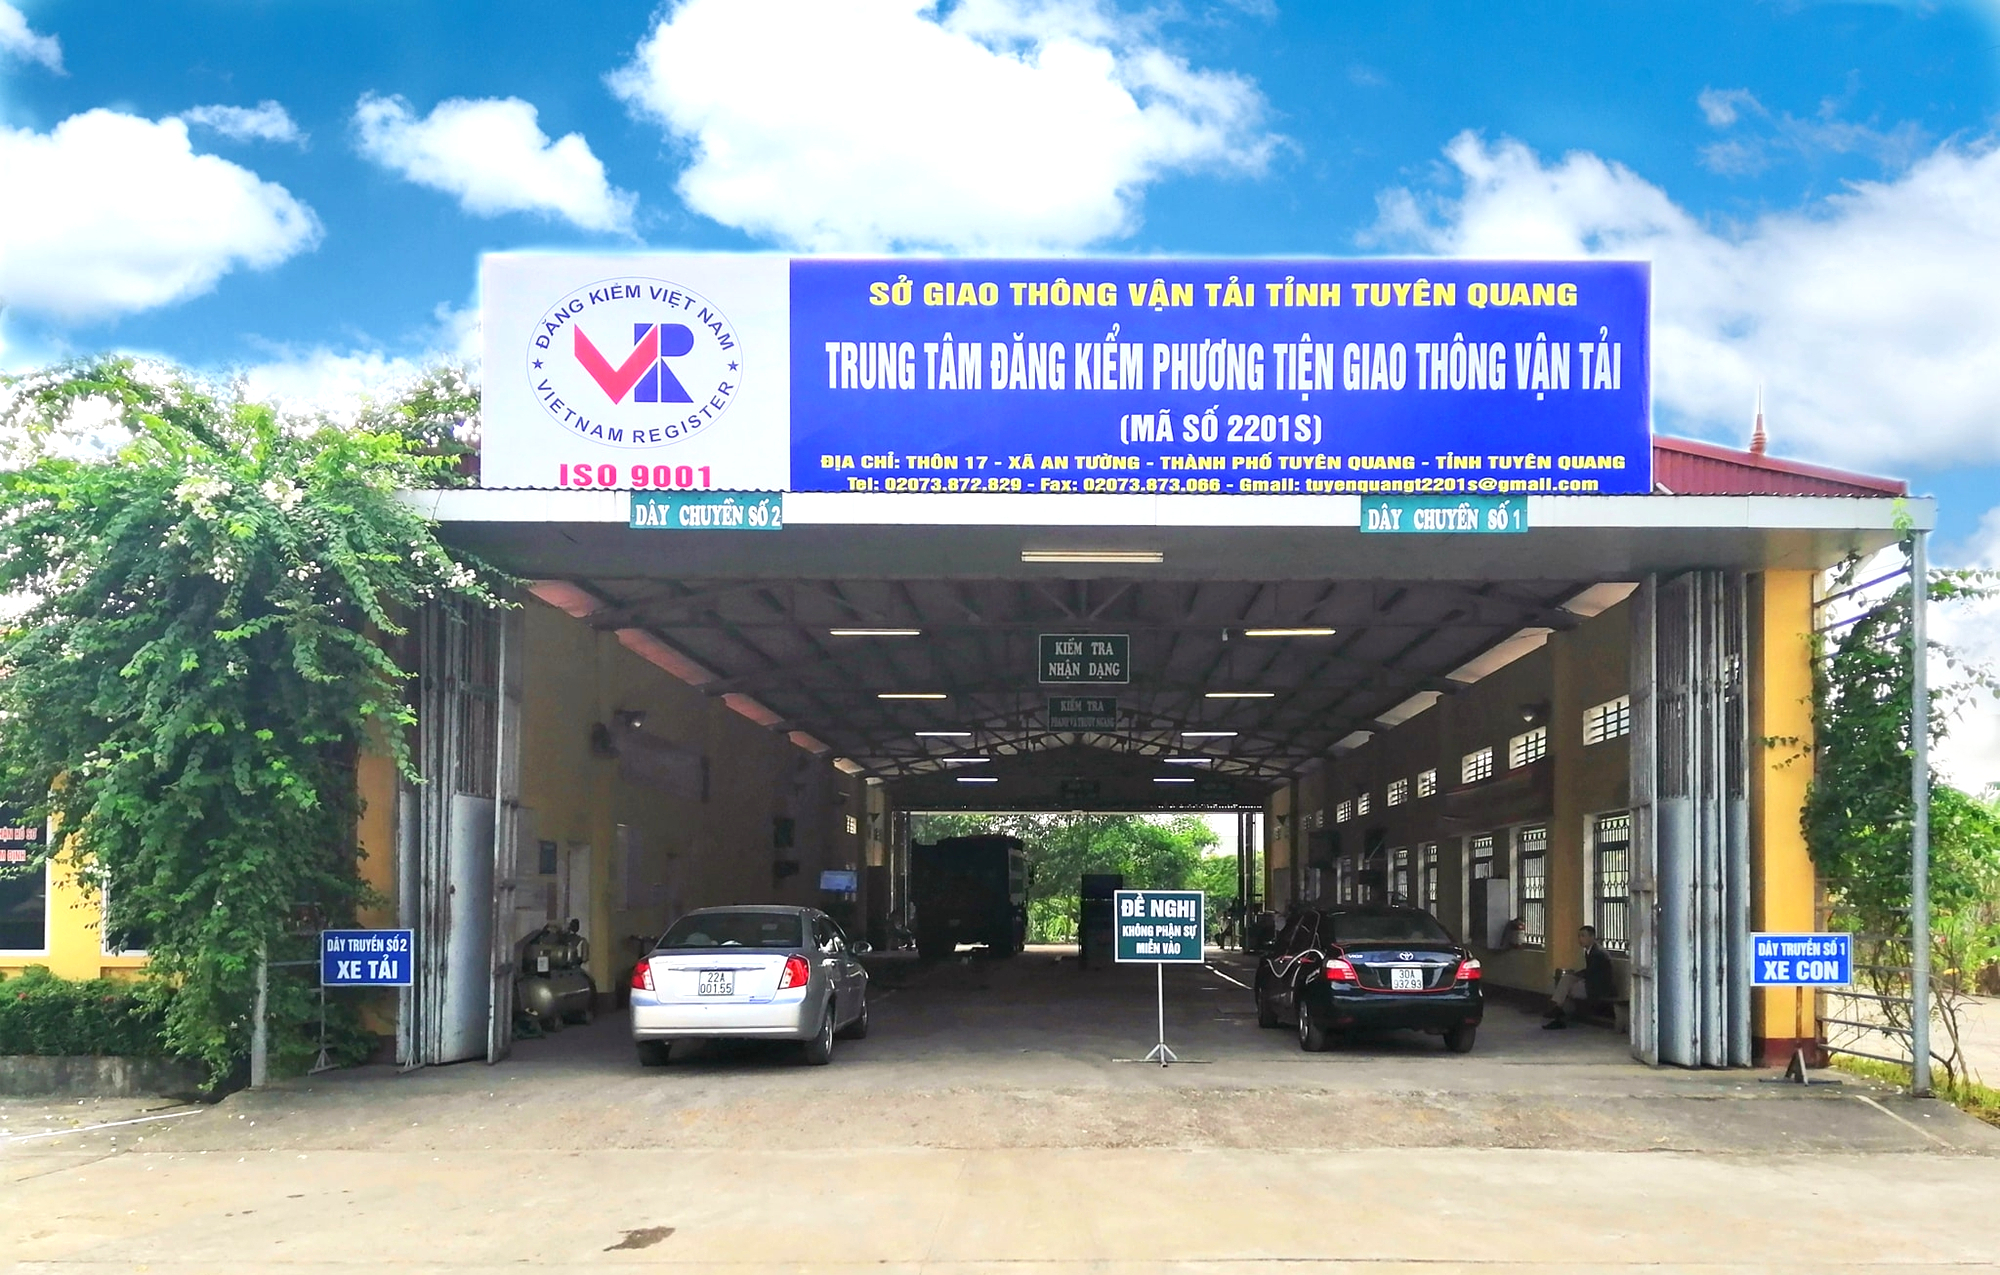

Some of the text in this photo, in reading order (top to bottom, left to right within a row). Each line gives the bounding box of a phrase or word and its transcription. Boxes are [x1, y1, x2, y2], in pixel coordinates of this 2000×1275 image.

[869, 275, 1578, 312] SỞ GIAO THÔNG VẬN TẢI TỈNH TUYÊN QUANG
[535, 283, 735, 351] ĐĂNG KIỂM VIỆT NAM
[825, 322, 1622, 401] TRUNG TÂM ĐĂNG KIỂM PHƯƠNG TIỆN GIAO THÔNG VẬN TẢI
[536, 378, 734, 444] VIETNAM REGISTER
[1120, 405, 1322, 446] (MÃ SỐ 2201S)
[820, 455, 855, 471] ĐỊA
[860, 451, 900, 469] CHỈ:
[905, 453, 959, 470] THÔN
[965, 455, 988, 470] 17
[1008, 454, 1035, 470] XÃ
[1041, 455, 1068, 470] AN
[1074, 452, 1140, 470] TƯỜNG
[1160, 453, 1226, 470] THÀNH
[1232, 452, 1273, 470] PHỐ
[1278, 453, 1342, 470] TUYÊN
[1347, 455, 1416, 471] QUANG
[1435, 452, 1482, 470] TỈNH
[1487, 453, 1552, 470] TUYÊN
[1557, 455, 1626, 471] QUANG
[559, 463, 711, 488] ISO 9001
[847, 477, 880, 491] Tel:
[885, 477, 1022, 492] 02073.872.829
[1040, 477, 1078, 492] Fax:
[1083, 477, 1221, 492] 02073.873.066
[1239, 477, 1300, 492] Gmail:
[1305, 477, 1599, 492] tuyenquangt2201s@gmail.com
[635, 498, 781, 527] DÂY CHUYỀN SỐ 2
[1368, 500, 1521, 530] DÂY CHUYỀN SỐ 1
[1090, 641, 1114, 656] TRA
[1048, 659, 1120, 679] NHẬN DẠNG
[1120, 892, 1196, 921] ĐỀ NGHỊ
[1122, 922, 1197, 939] KHÔNG PHẬN SỰ
[327, 936, 346, 952] DÂY
[1162, 940, 1181, 954] VÀO
[1758, 940, 1779, 956] DÂY
[1822, 937, 1838, 956] SỐ
[1839, 942, 1845, 956] 1
[337, 953, 398, 979] XE TẢI
[1399, 969, 1415, 978] 30A
[1763, 960, 1839, 980] XE CON
[707, 972, 725, 983] 22A
[700, 983, 733, 994] 001.55
